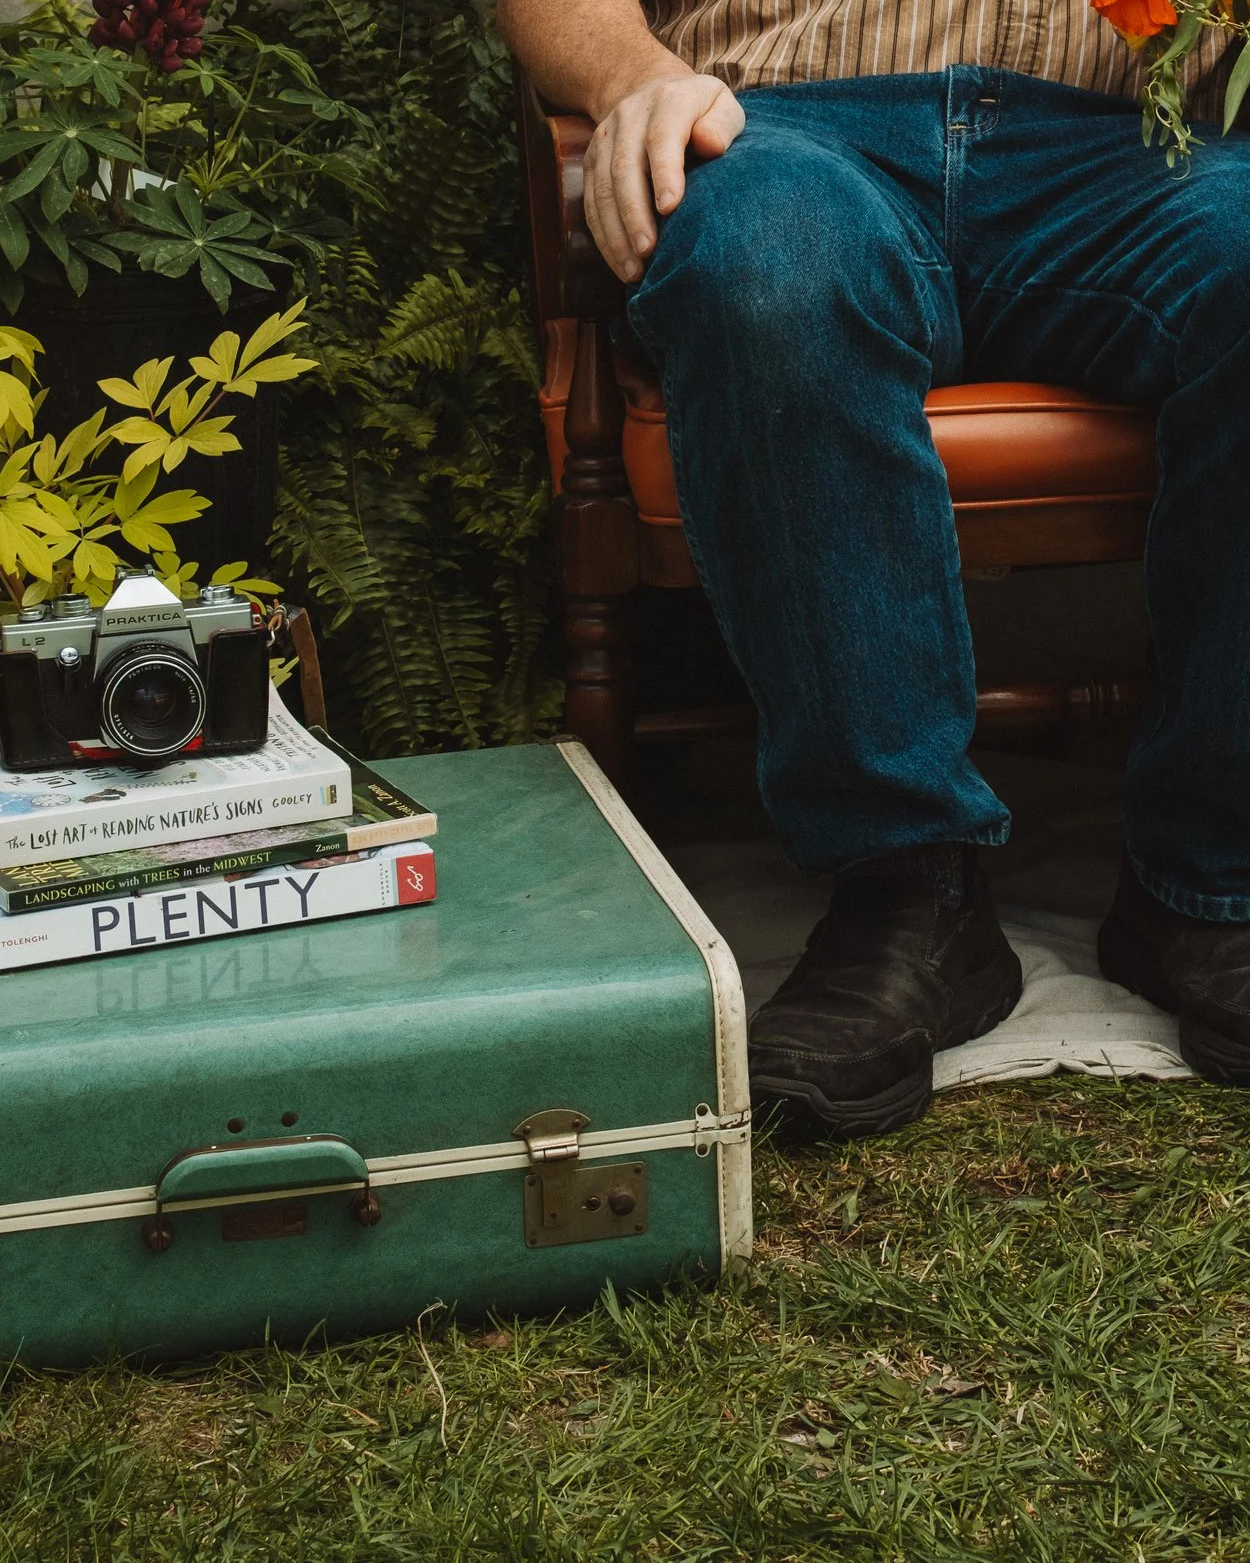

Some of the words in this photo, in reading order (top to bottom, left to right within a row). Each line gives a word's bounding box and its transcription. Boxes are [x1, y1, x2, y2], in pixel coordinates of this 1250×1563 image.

[106, 612, 182, 626] PRAKTICA
[272, 793, 312, 808] GOOLEY
[62, 823, 88, 844] ART
[102, 814, 155, 839] READING
[159, 802, 219, 831] NATURE'S
[226, 798, 263, 821] SIGNS
[315, 842, 341, 853] Zanon
[25, 880, 116, 905] LANDSCAPING
[118, 876, 140, 889] with
[142, 868, 180, 884] TREES
[183, 868, 193, 877] in
[195, 864, 211, 875] the
[213, 852, 272, 872] MIDWEST
[92, 871, 320, 952] PLENTY
